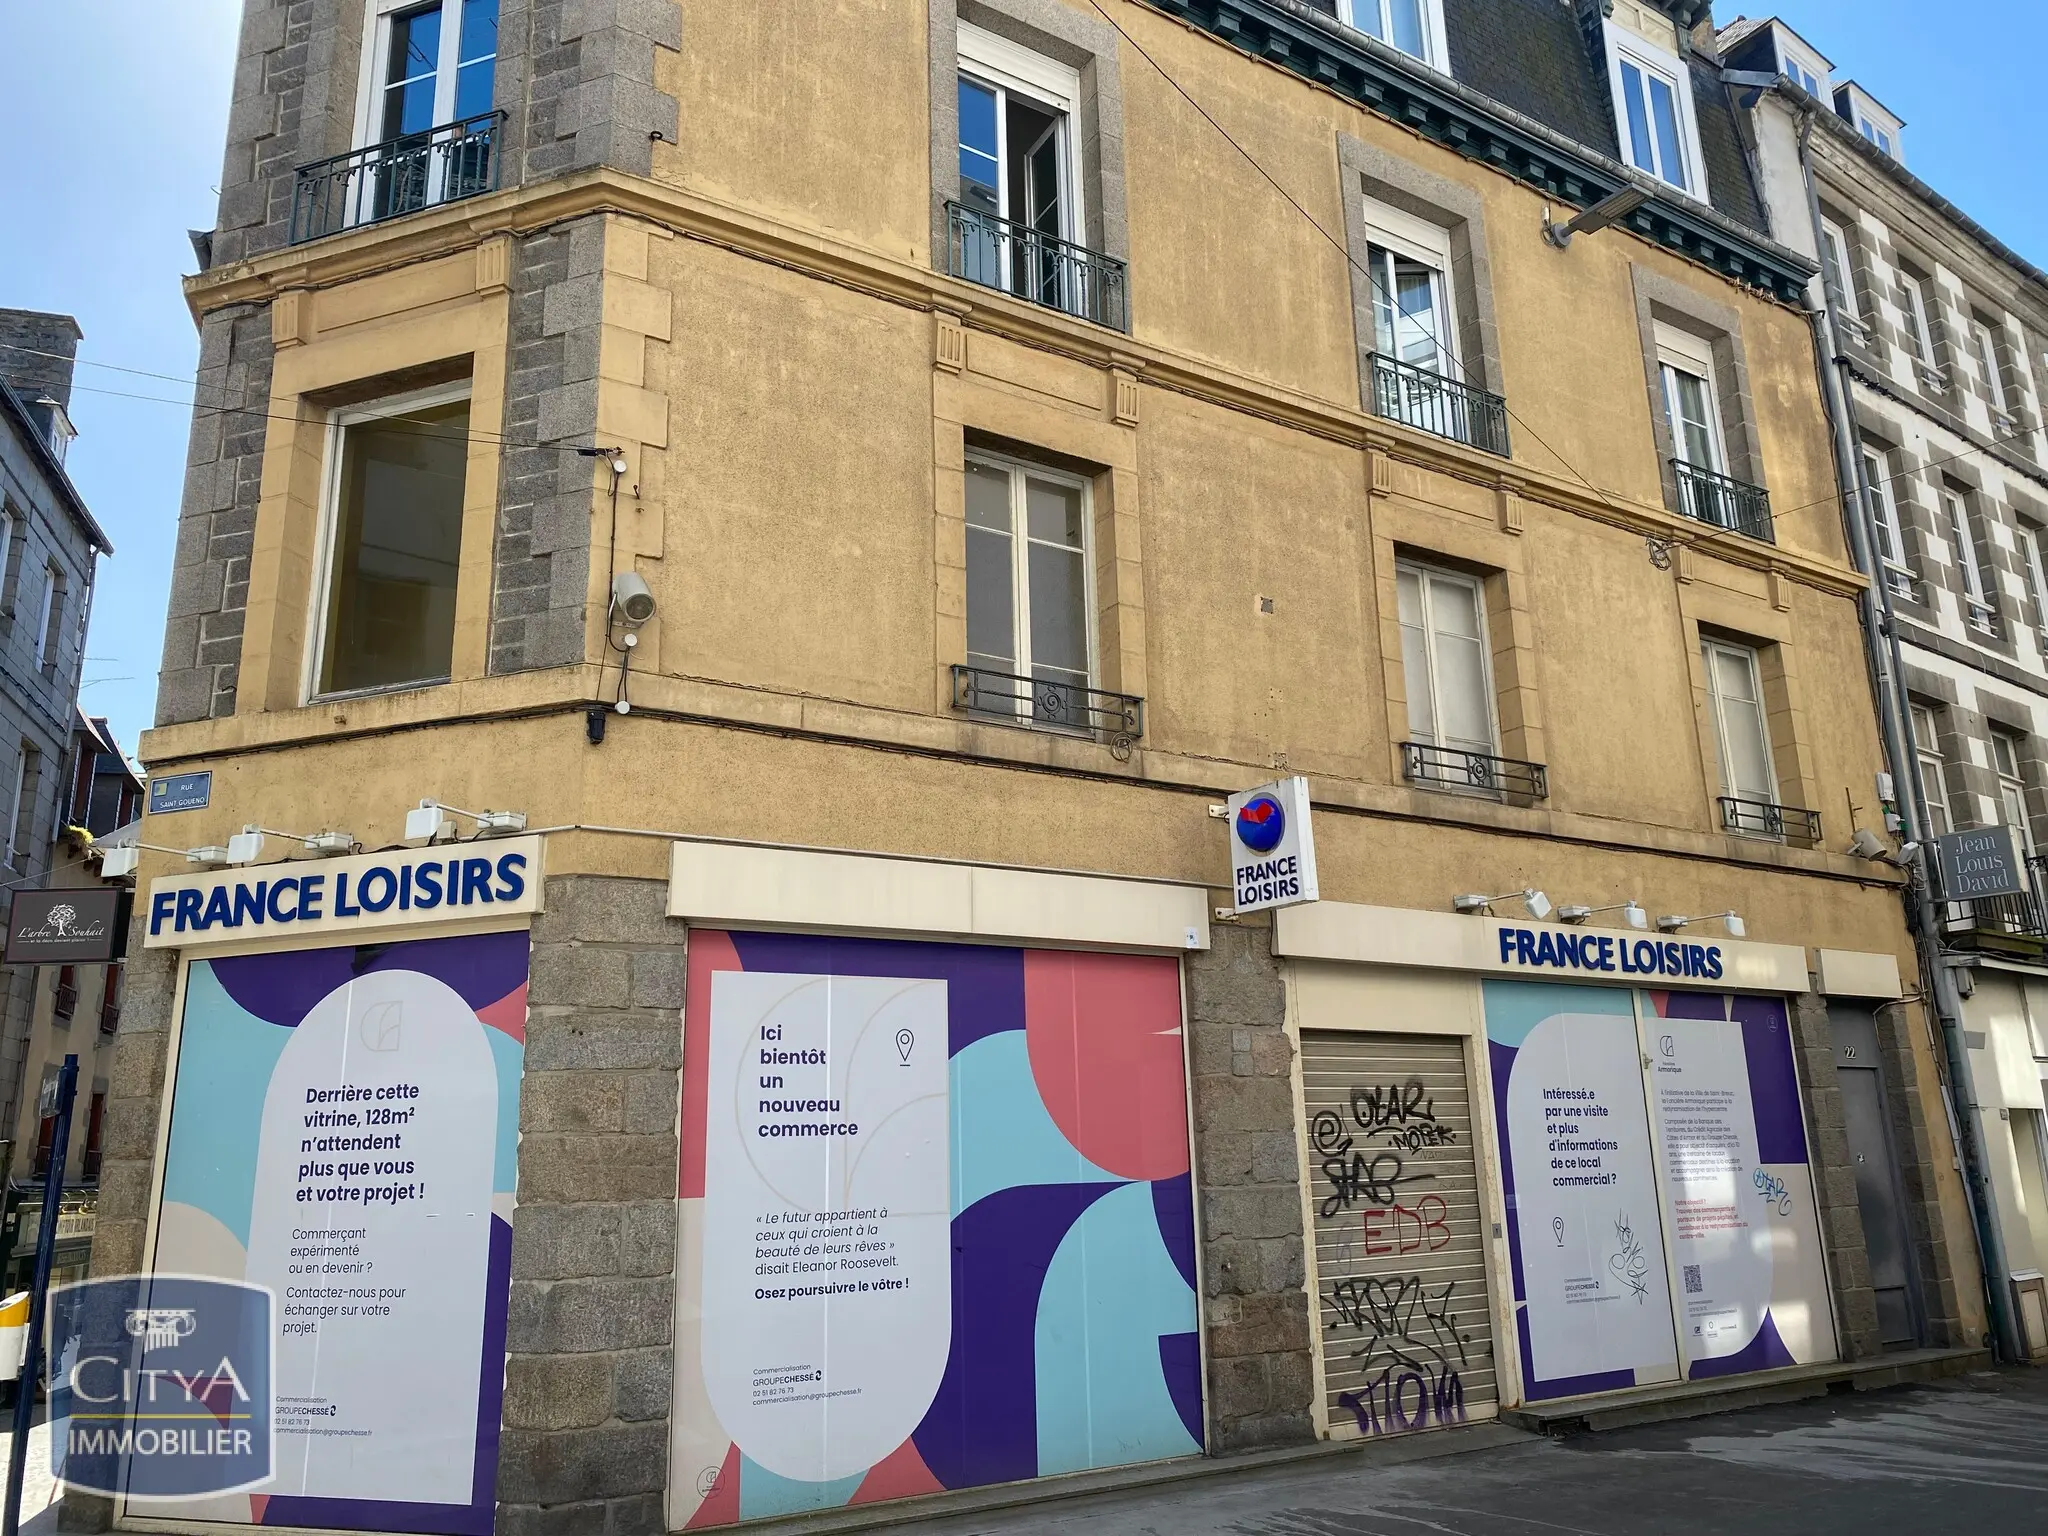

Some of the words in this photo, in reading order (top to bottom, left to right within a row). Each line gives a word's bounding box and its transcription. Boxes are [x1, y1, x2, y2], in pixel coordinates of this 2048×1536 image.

[160, 800, 176, 808] SAINT
[1955, 835, 1996, 855] Jean
[1237, 856, 1297, 885] FRANCE
[1956, 852, 2003, 874] Louis
[1957, 869, 2010, 893] David
[150, 875, 325, 935] FRANCE
[335, 854, 527, 917] LOISIRS
[1238, 877, 1299, 905] LOISIRS
[18, 922, 51, 937] L'arbre
[69, 920, 104, 936] Souhait
[1499, 928, 1616, 972] FRANCE
[1620, 938, 1722, 979] LOISIRS
[761, 1025, 782, 1041] Ici
[760, 1048, 826, 1064] bientôt
[1845, 1046, 1856, 1058] 22
[760, 1076, 783, 1088] un
[306, 1085, 372, 1103] Derrière
[376, 1084, 419, 1100] cette
[1543, 1087, 1595, 1099] Intéressé.e
[759, 1100, 840, 1113] nouveau
[1545, 1108, 1561, 1120] par
[1564, 1108, 1581, 1116] une
[1583, 1105, 1608, 1116] visite
[304, 1110, 361, 1128] vitrine,
[366, 1107, 415, 1125] 128m²
[758, 1123, 858, 1137] commerce
[1547, 1123, 1557, 1133] et
[1559, 1123, 1579, 1137] plus
[301, 1134, 401, 1152] n’attendent
[1551, 1157, 1563, 1169] de
[1565, 1159, 1576, 1168] ce
[1578, 1157, 1601, 1168] local
[299, 1161, 333, 1182] plus
[338, 1162, 369, 1181] que
[374, 1161, 414, 1174] vous
[1553, 1173, 1610, 1186] commercial
[1612, 1173, 1616, 1184] ?
[296, 1186, 312, 1202] et
[316, 1186, 360, 1201] votre
[364, 1182, 415, 1205] projet
[419, 1183, 424, 1198] !
[766, 1213, 779, 1224] Le
[782, 1211, 811, 1223] futur
[815, 1208, 876, 1223] appartient
[880, 1207, 888, 1218] à
[292, 1228, 366, 1242] Commerçant
[756, 1231, 785, 1241] ceux
[789, 1229, 808, 1242] qui
[811, 1225, 852, 1238] croient
[856, 1224, 863, 1235] à
[867, 1224, 878, 1235] la
[290, 1244, 359, 1260] expérimenté
[756, 1245, 800, 1258] beauté
[804, 1244, 819, 1256] de
[823, 1243, 851, 1254] leurs
[855, 1241, 886, 1252] rêves
[289, 1265, 302, 1273] ou
[305, 1264, 319, 1273] en
[322, 1262, 364, 1273] devenir
[367, 1262, 372, 1272] ?
[755, 1263, 789, 1275] disait
[793, 1260, 837, 1272] Eleanor
[841, 1255, 899, 1270] Roosevelt.
[286, 1287, 376, 1298] Contactez-nous
[379, 1288, 406, 1301] pour
[755, 1289, 785, 1299] Osez
[789, 1282, 855, 1300] poursuivre
[858, 1281, 868, 1291] le
[872, 1279, 902, 1291] vôtre
[905, 1278, 909, 1288] !
[285, 1304, 338, 1319] échanger
[341, 1306, 358, 1315] sur
[361, 1305, 390, 1315] votre
[283, 1321, 317, 1336] projet.
[753, 1364, 811, 1375] Commercialisation
